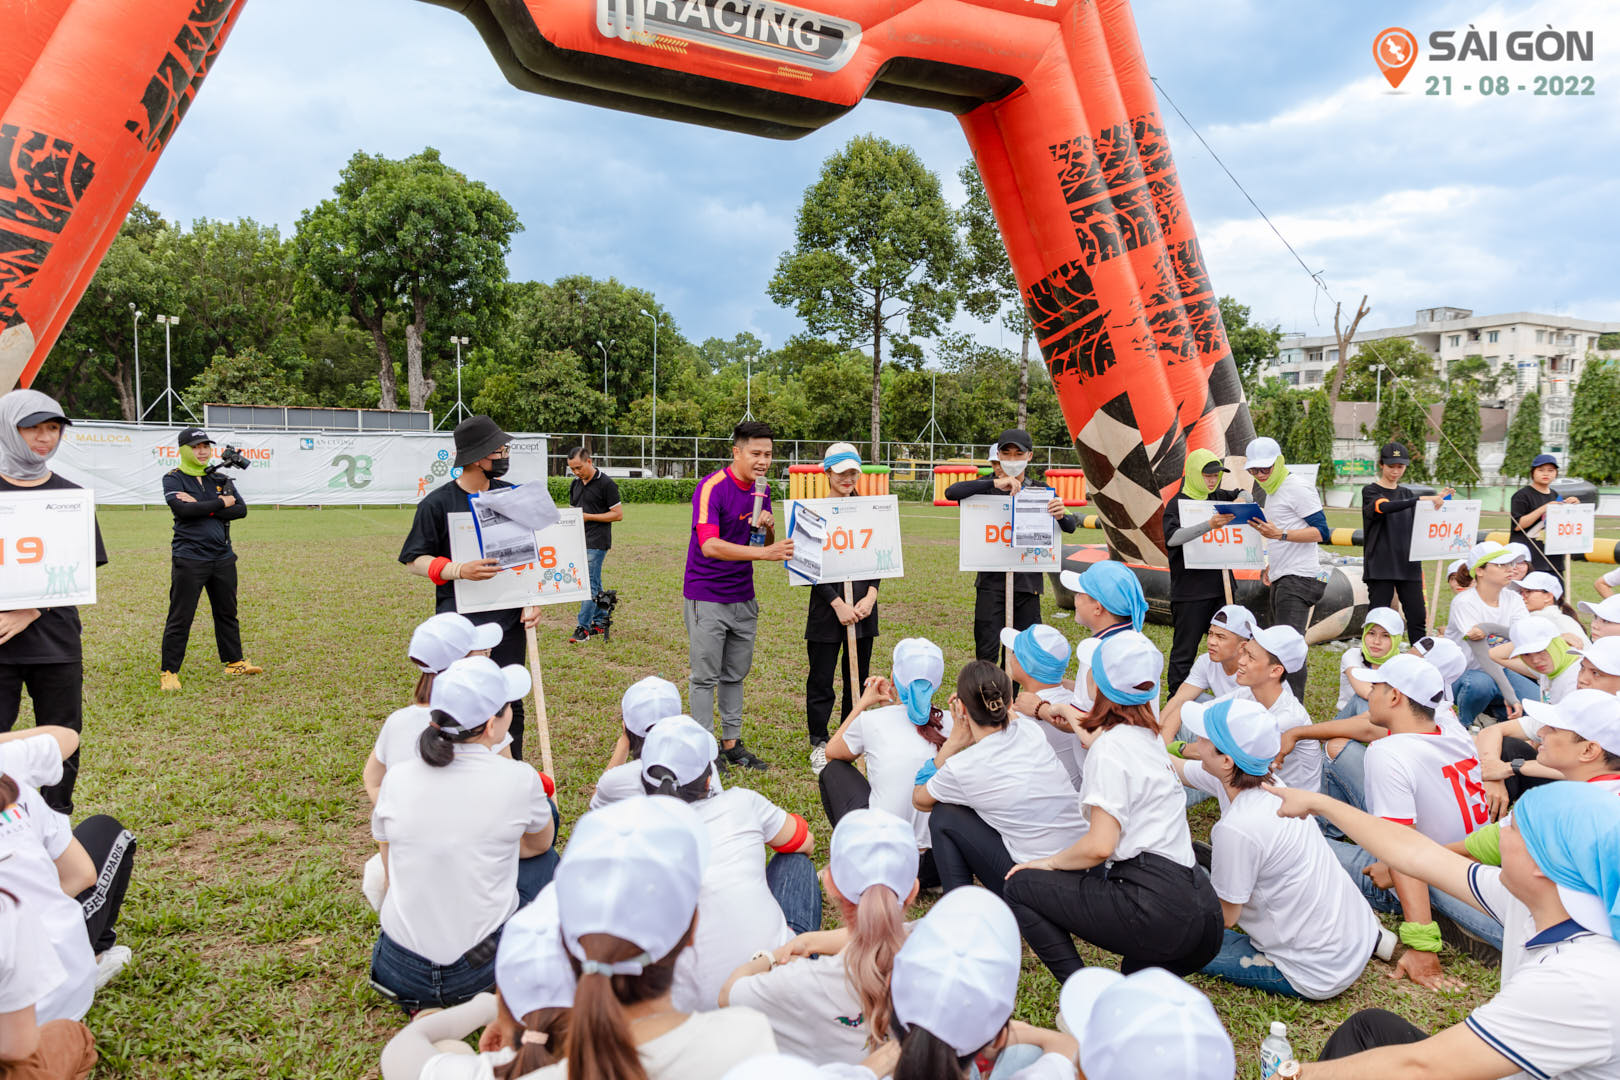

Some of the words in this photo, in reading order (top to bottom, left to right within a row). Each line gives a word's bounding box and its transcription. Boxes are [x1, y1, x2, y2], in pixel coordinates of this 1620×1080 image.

[76, 433, 132, 443] MALLOCA
[860, 528, 873, 549] 7
[985, 521, 1012, 548] ĐỘ
[1232, 527, 1244, 545] 5
[1428, 520, 1452, 542] ĐỘI
[1454, 522, 1464, 537] 4
[1576, 523, 1583, 536] 3
[16, 536, 44, 565] 9
[539, 546, 558, 569] 8
